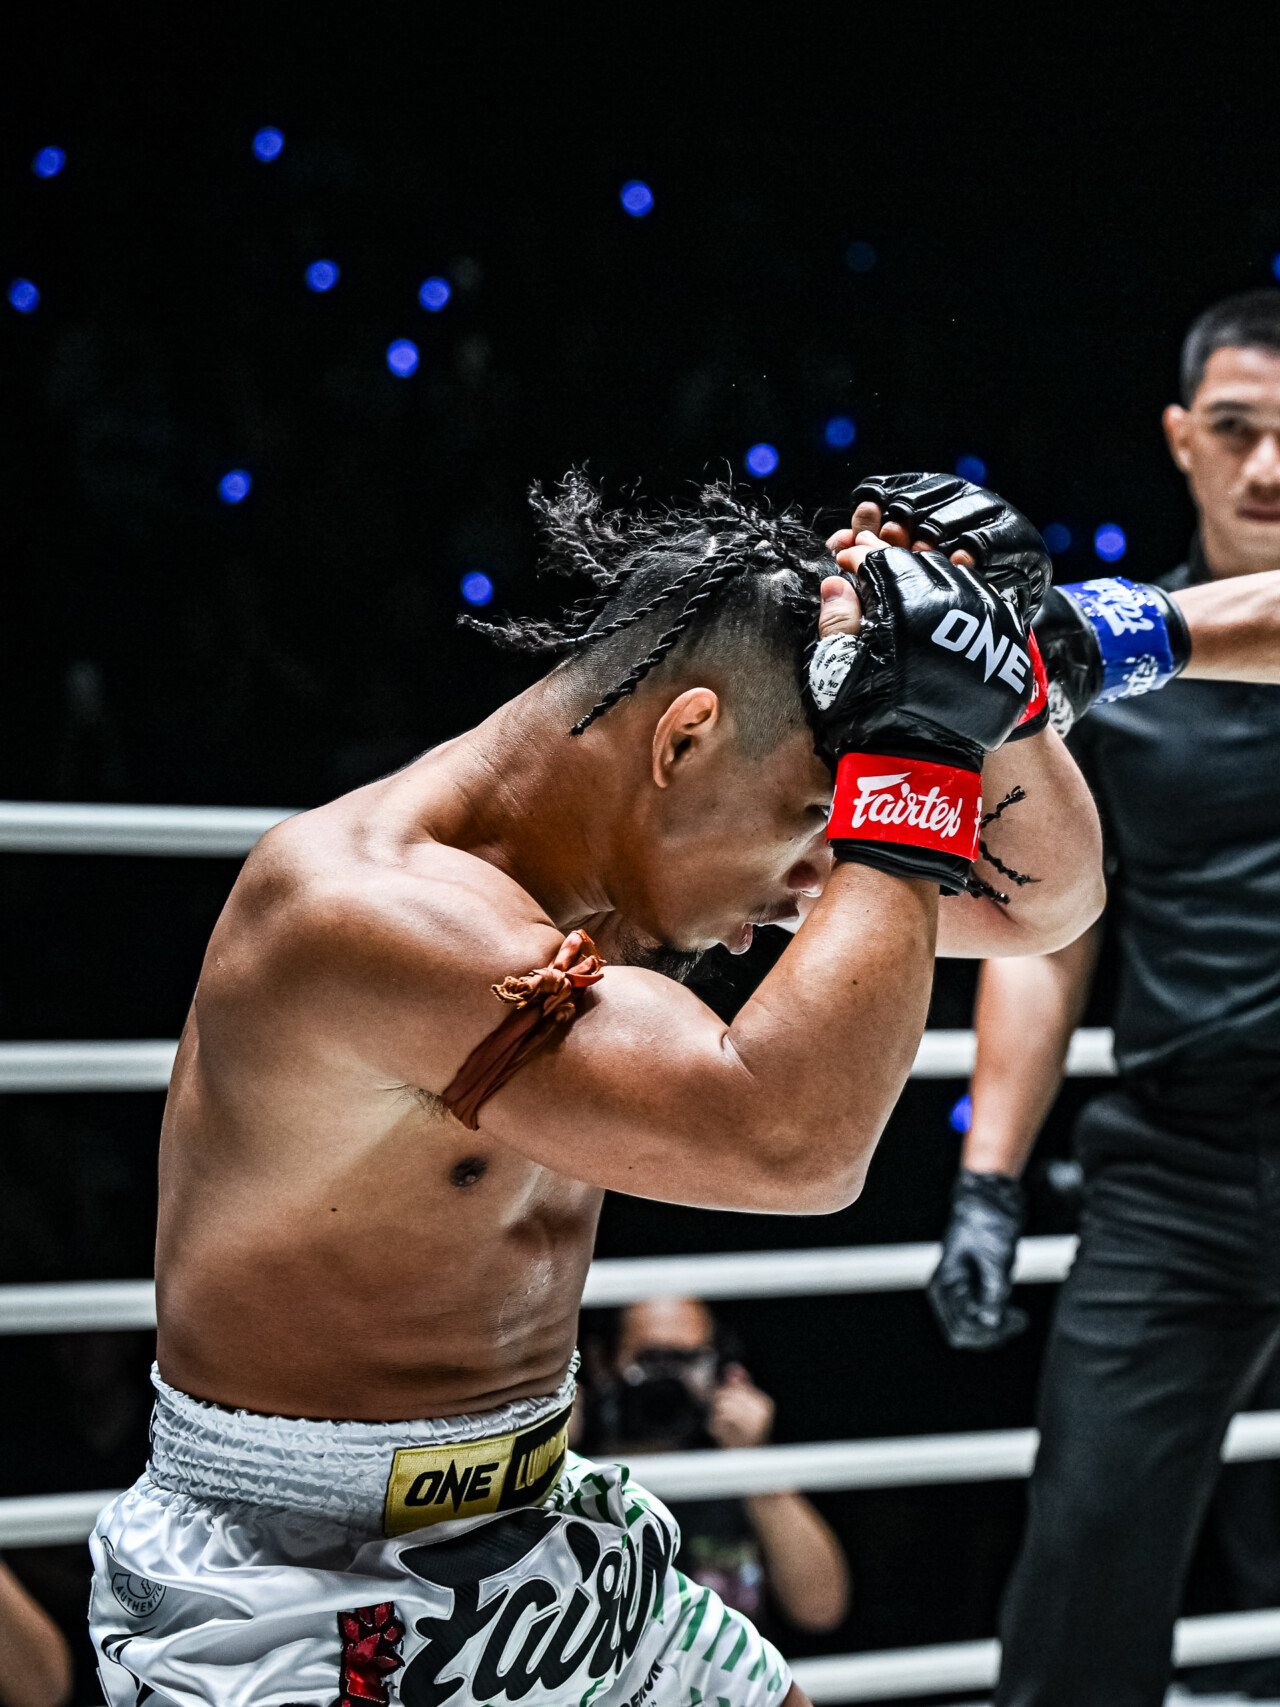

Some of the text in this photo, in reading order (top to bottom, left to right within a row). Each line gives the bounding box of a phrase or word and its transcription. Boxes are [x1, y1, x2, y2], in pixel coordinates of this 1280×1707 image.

[930, 608, 1031, 694] ONE
[850, 771, 963, 839] Fairtex
[404, 1459, 500, 1513] ONE
